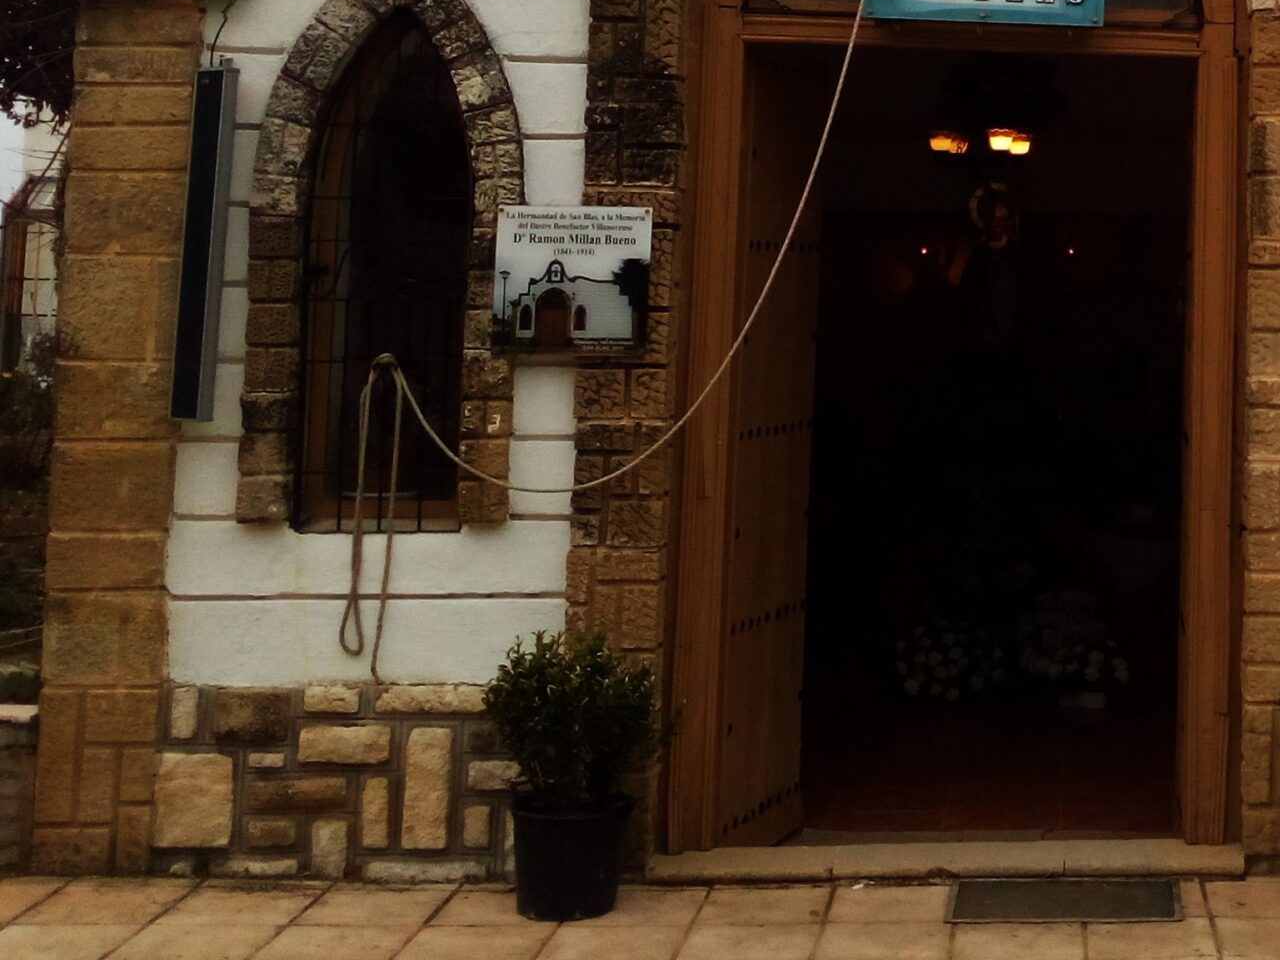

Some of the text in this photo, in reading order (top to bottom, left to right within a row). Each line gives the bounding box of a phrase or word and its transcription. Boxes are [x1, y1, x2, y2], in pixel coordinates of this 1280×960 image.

[506, 212, 515, 220] La
[559, 212, 567, 220] de
[569, 212, 582, 220] San
[607, 213, 615, 221] la
[529, 233, 565, 244] Ramon
[604, 234, 636, 245] Bueno
